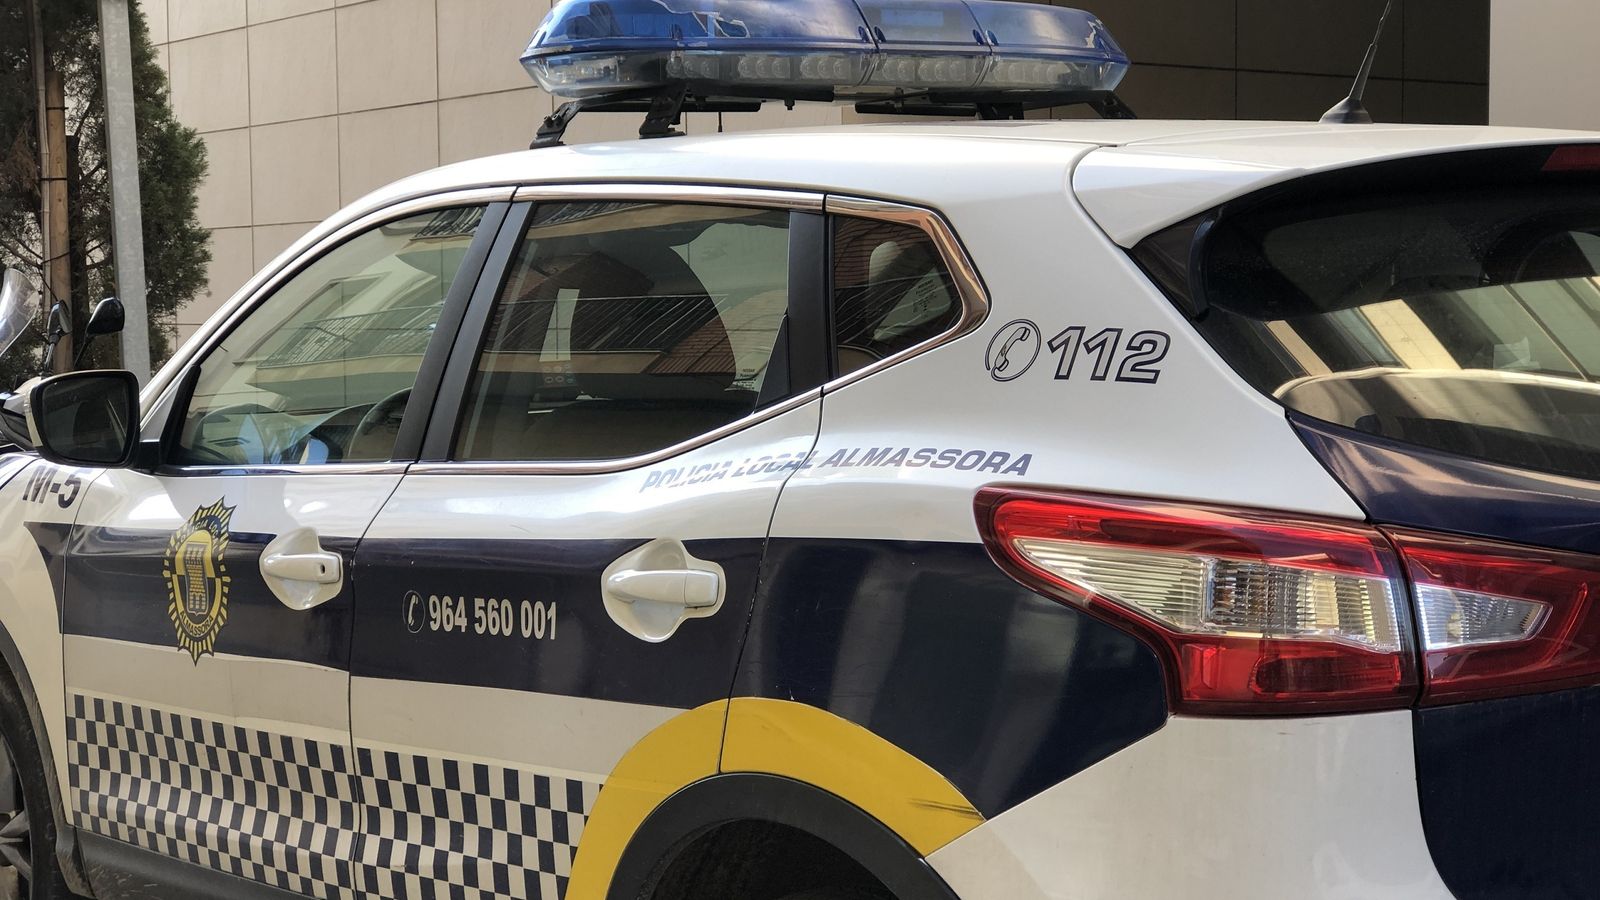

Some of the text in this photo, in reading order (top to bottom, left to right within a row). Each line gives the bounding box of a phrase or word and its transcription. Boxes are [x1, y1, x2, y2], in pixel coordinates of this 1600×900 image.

[1047, 326, 1171, 384] 112
[730, 450, 820, 478] LOCAL
[818, 447, 1033, 477] ALMASSORA
[22, 465, 93, 509] M-5
[180, 611, 213, 636] ALMASSORA
[428, 594, 557, 640] 964 560 001
